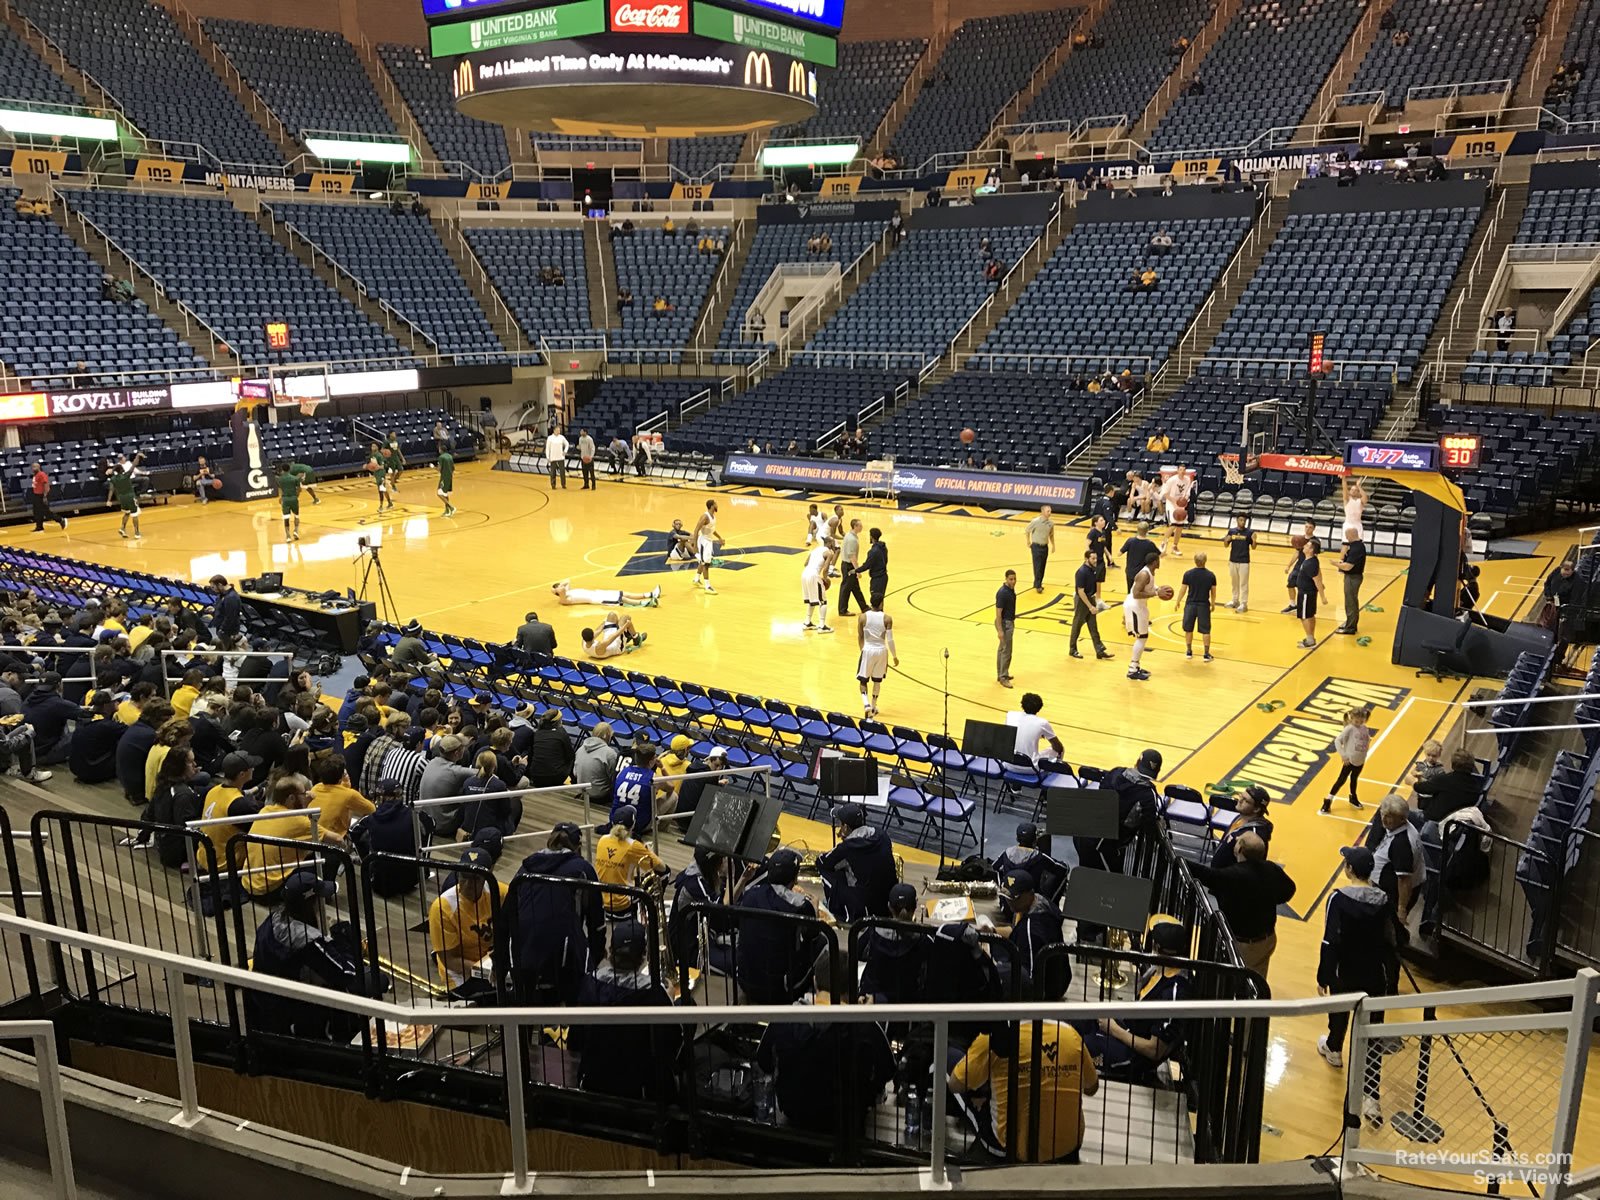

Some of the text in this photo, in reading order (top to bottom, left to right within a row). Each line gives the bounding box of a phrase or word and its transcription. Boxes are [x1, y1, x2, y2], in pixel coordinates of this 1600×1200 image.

[482, 8, 558, 36] UNITED BANK
[615, 3, 682, 28] Coca-Cola
[483, 38, 501, 48] WEST
[539, 29, 558, 39] BANK
[744, 17, 806, 47] UNITED BANK
[479, 64, 494, 79] For
[494, 61, 503, 76] A
[503, 55, 550, 75] Limited
[551, 54, 587, 71] Time
[589, 53, 624, 72] Only
[627, 53, 645, 69] At
[1466, 141, 1495, 158] 109
[28, 158, 50, 174] 101
[1185, 162, 1208, 176] 108
[1233, 152, 1339, 173] MOUNTAINEES
[147, 167, 172, 183] 102
[1101, 165, 1155, 180] LET'S GO
[321, 180, 342, 193] 103
[479, 185, 500, 198] 104
[682, 186, 702, 199] 105
[271, 334, 286, 346] 30
[51, 392, 126, 413] KOVAL
[1363, 448, 1404, 464] I-77
[1449, 450, 1471, 464] 30
[730, 461, 758, 472] Frontier
[765, 464, 792, 475] OFFICIAL
[792, 466, 821, 478] PARTNER
[821, 468, 831, 479] OF
[831, 469, 847, 480] WVU
[846, 471, 883, 483] ATHLETICS
[1298, 458, 1346, 473] State Farm
[893, 474, 927, 487] Frontier
[935, 477, 1076, 499] OFFICIAL PARTNER OF WVU ATHLETICS
[245, 488, 272, 498] gomart
[1302, 678, 1402, 722] WEST
[625, 771, 643, 782] WEST
[617, 781, 642, 806] 44
